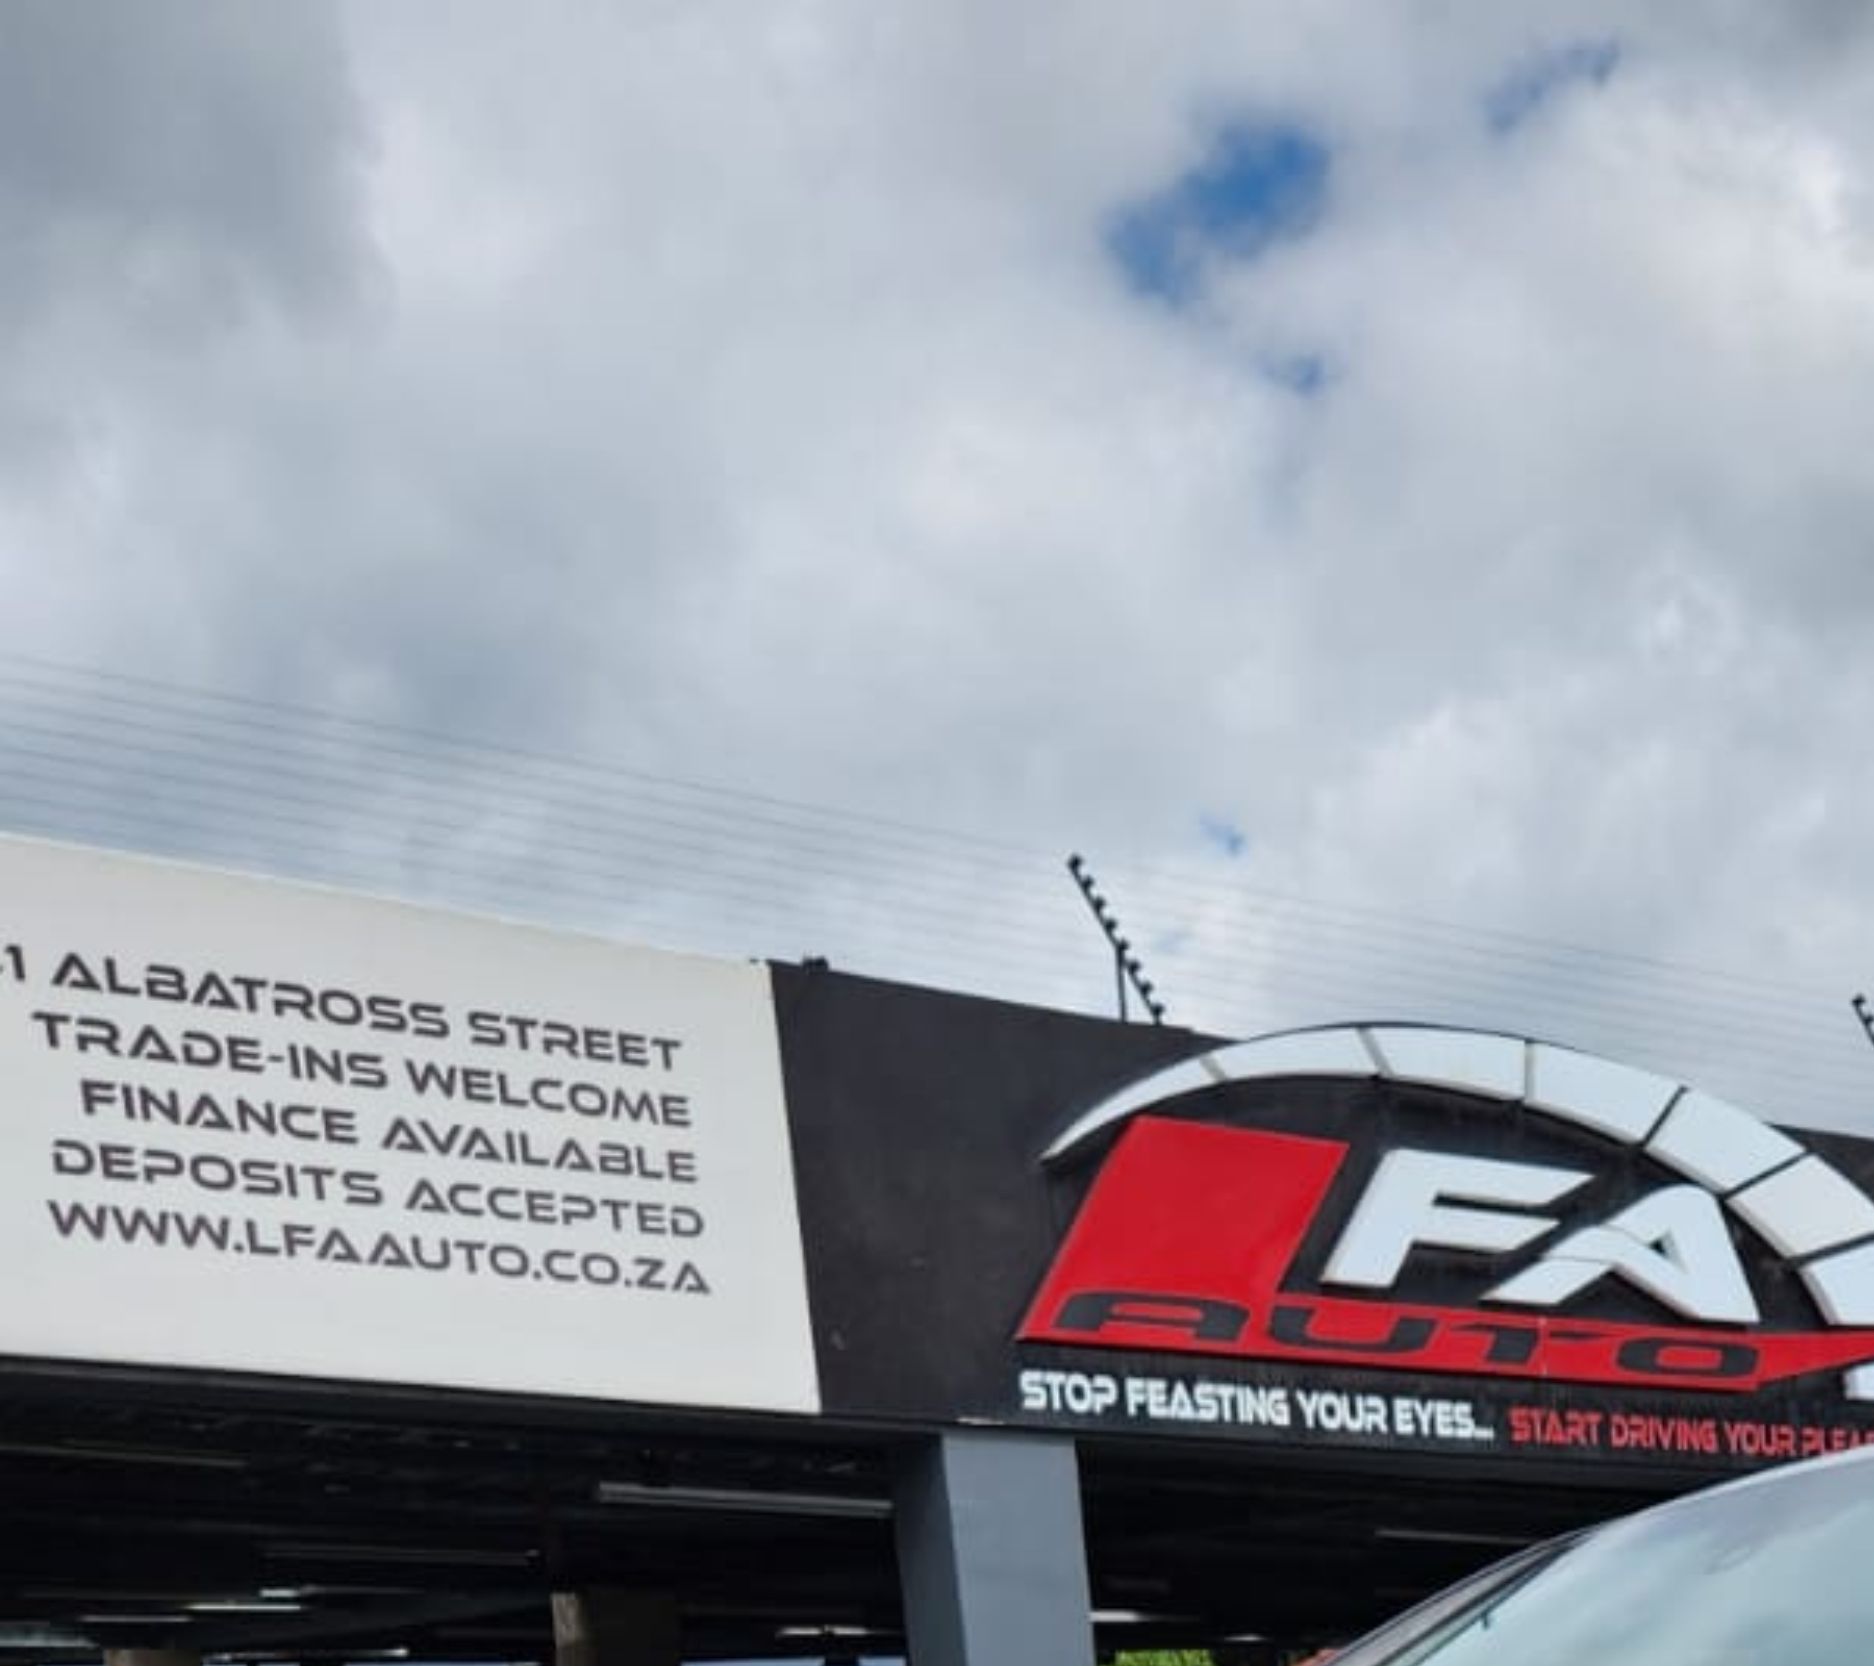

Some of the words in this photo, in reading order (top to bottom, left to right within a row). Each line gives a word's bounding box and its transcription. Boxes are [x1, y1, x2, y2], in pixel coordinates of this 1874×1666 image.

[0, 944, 26, 983] 1
[51, 953, 450, 1039] ALBATROSS
[468, 1011, 683, 1072] STREET
[31, 1011, 388, 1090] TRADE-INS
[405, 1059, 693, 1128] WELCOME
[80, 1079, 360, 1145] FINANCE
[382, 1117, 699, 1184] AVAILABLE
[51, 1139, 384, 1205] DEPOSITS
[405, 1178, 704, 1238] ACCEPTED
[48, 1201, 712, 1296] WWW.LFAAUTO.CO.ZA
[1052, 1290, 1760, 1377] AUTO
[1018, 1369, 1118, 1415] STOP
[1125, 1376, 1291, 1427] FEASTING
[1296, 1392, 1388, 1433] YOUR
[1508, 1407, 1602, 1444] START
[1609, 1412, 1718, 1455] DRIVING
[1722, 1420, 1797, 1457] YOUR
